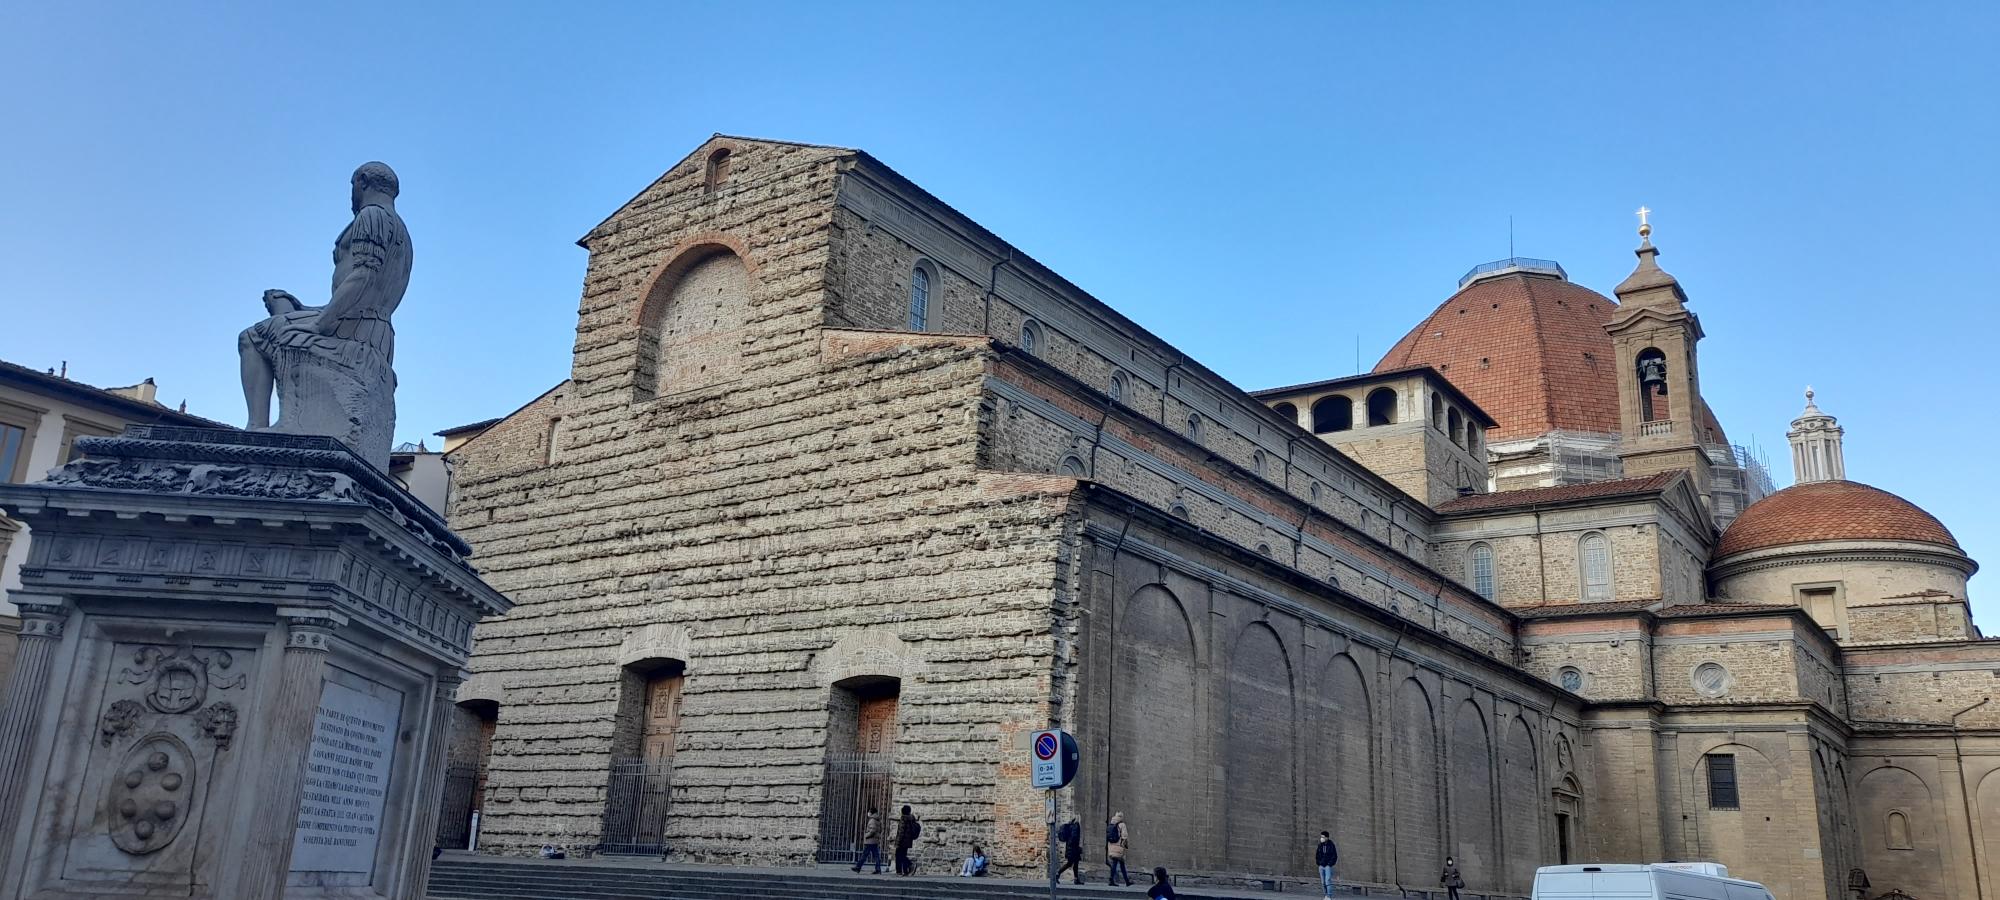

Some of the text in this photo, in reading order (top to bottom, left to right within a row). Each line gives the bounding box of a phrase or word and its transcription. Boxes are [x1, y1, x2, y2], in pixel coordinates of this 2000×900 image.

[316, 705, 325, 717] UNA
[325, 708, 339, 720] PARTE
[345, 714, 361, 726] QUESTO
[362, 718, 385, 733] MONUMENTO
[320, 722, 343, 736] DESTINATO
[344, 742, 362, 754] MEMORIA
[313, 749, 373, 769] GIOVANNI DELLE BANDE NERE
